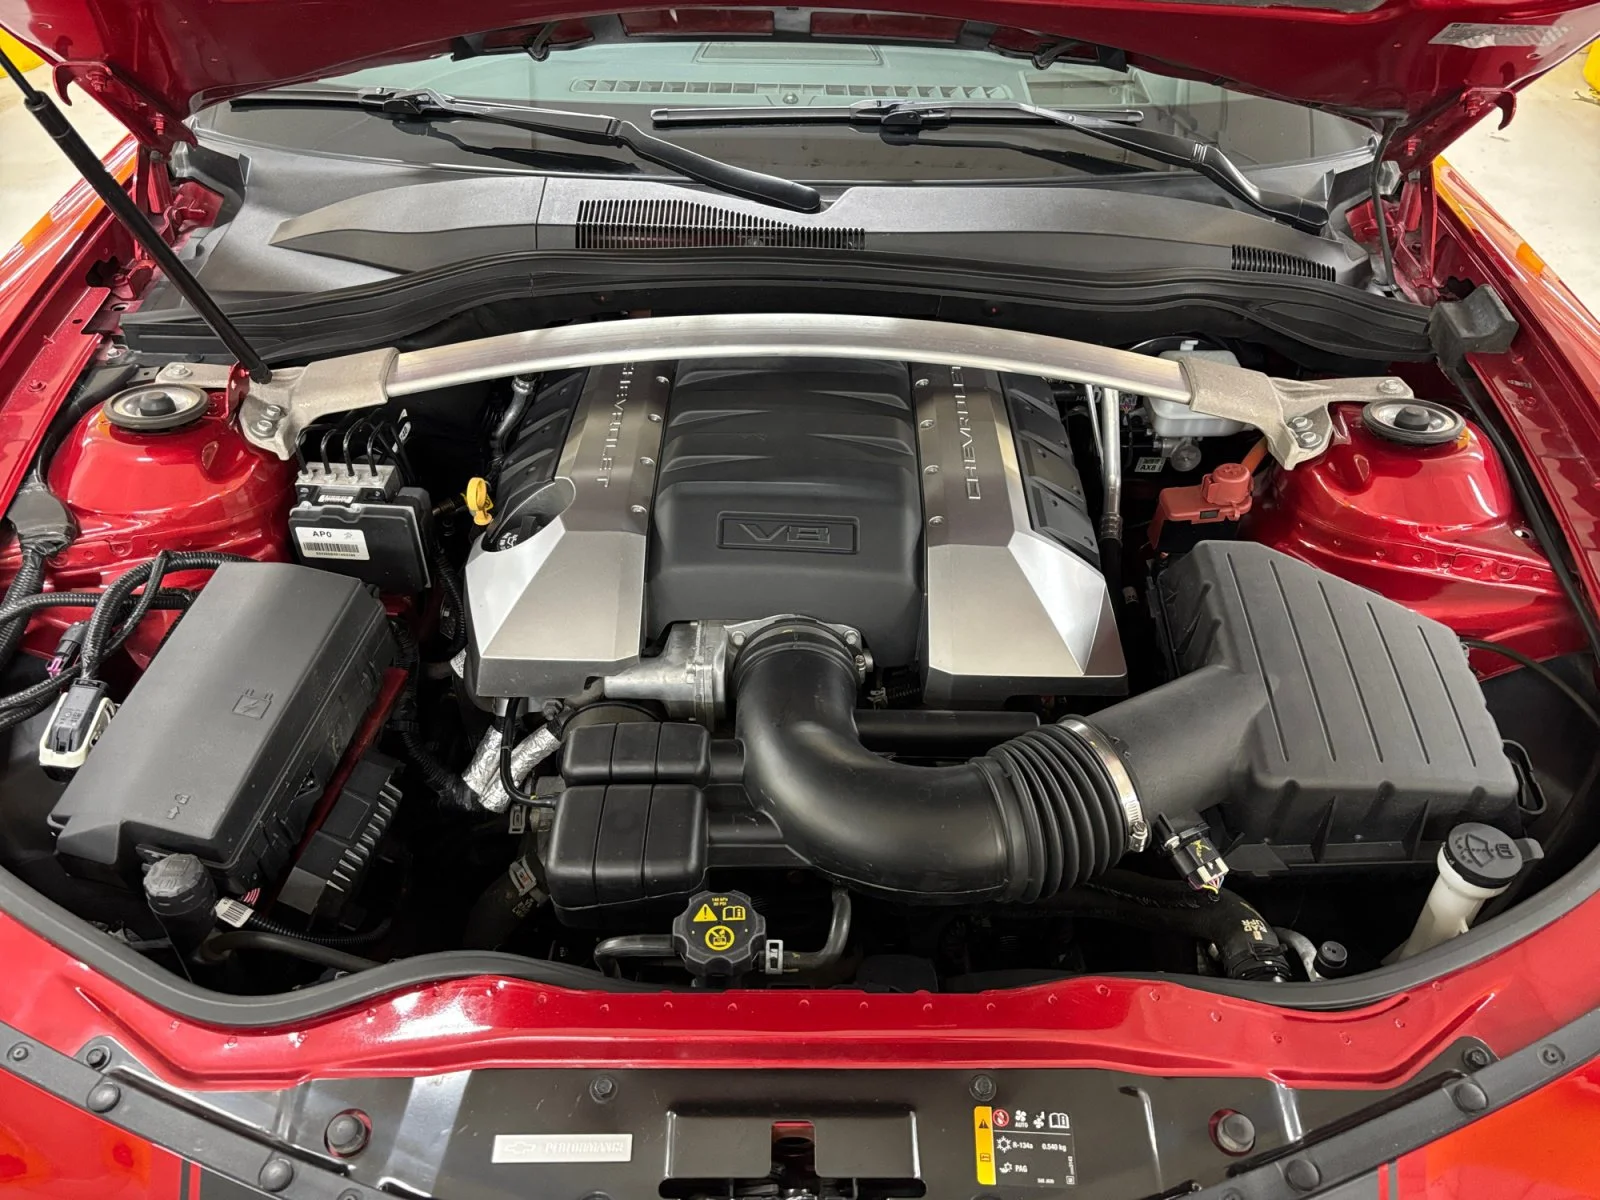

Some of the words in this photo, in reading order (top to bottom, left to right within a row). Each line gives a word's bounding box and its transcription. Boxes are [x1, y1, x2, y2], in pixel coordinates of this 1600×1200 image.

[738, 523, 830, 544] V8
[1012, 1141, 1033, 1149] R-134a
[1059, 1143, 1067, 1152] kg
[1015, 1165, 1028, 1173] PAG
